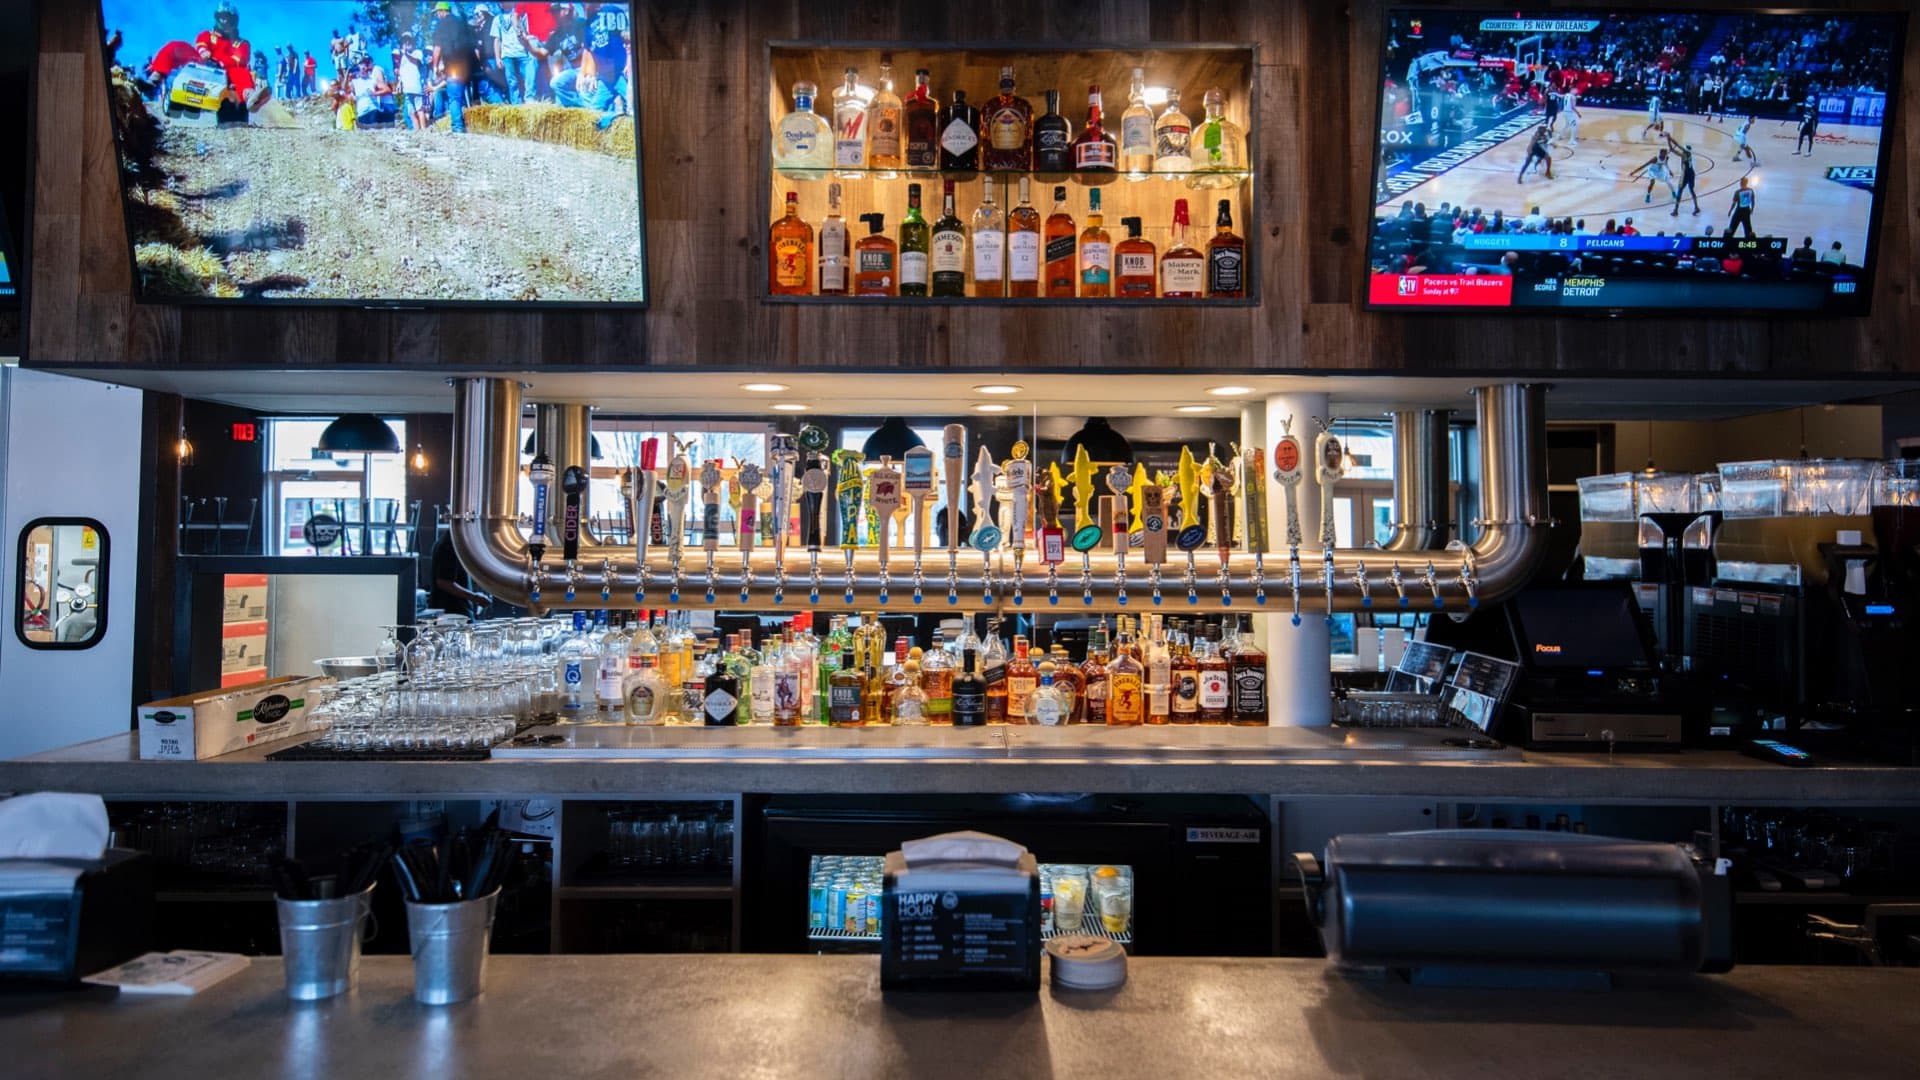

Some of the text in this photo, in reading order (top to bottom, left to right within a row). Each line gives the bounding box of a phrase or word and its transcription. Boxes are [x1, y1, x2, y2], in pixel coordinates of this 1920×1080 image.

[1524, 21, 1534, 29] FS
[1536, 21, 1552, 30] NEW
[1555, 21, 1588, 31] ORLEANS
[935, 234, 963, 244] JAMESON
[1474, 238, 1511, 246] NUGGETS
[1559, 238, 1568, 247] 8
[1586, 239, 1625, 247] PELICANS
[1672, 239, 1680, 249] 7
[1711, 241, 1724, 249] Qtr
[1738, 241, 1757, 249] 8:45
[863, 253, 883, 261] KNOB
[1125, 257, 1145, 266] KNOB
[1424, 278, 1448, 286] Pacers
[1459, 278, 1475, 286] Trail
[1476, 279, 1503, 287] Blazers
[1563, 278, 1605, 287] MEMPHIS
[1423, 287, 1442, 295] Sunday
[1563, 287, 1600, 297] DETROIT
[810, 429, 820, 443] 3
[565, 504, 578, 541] CIDER
[1535, 644, 1561, 653] Focus
[834, 688, 852, 697] KNOB
[898, 893, 939, 905] HAPPY
[898, 905, 935, 916] HOUR
